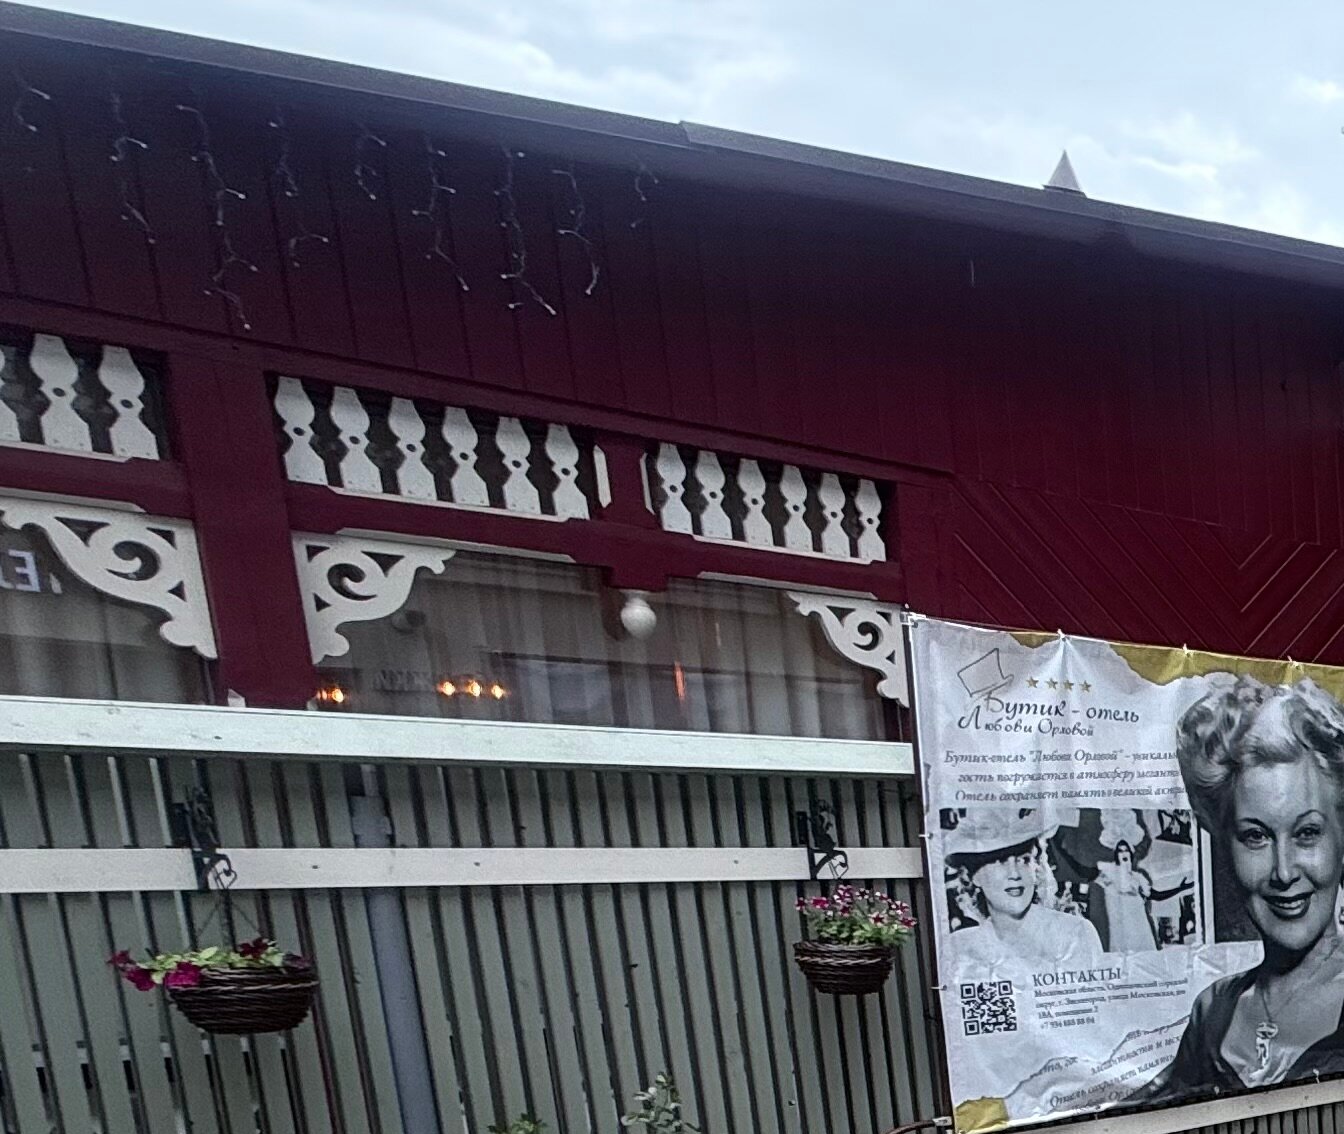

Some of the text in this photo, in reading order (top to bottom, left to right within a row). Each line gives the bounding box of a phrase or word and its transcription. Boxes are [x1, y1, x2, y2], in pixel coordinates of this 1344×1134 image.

[958, 705, 1094, 737] Любови Орловой
[984, 691, 1067, 721] Бутик
[1086, 706, 1140, 723] отель
[1032, 967, 1121, 987] КОНТАКТЫ
